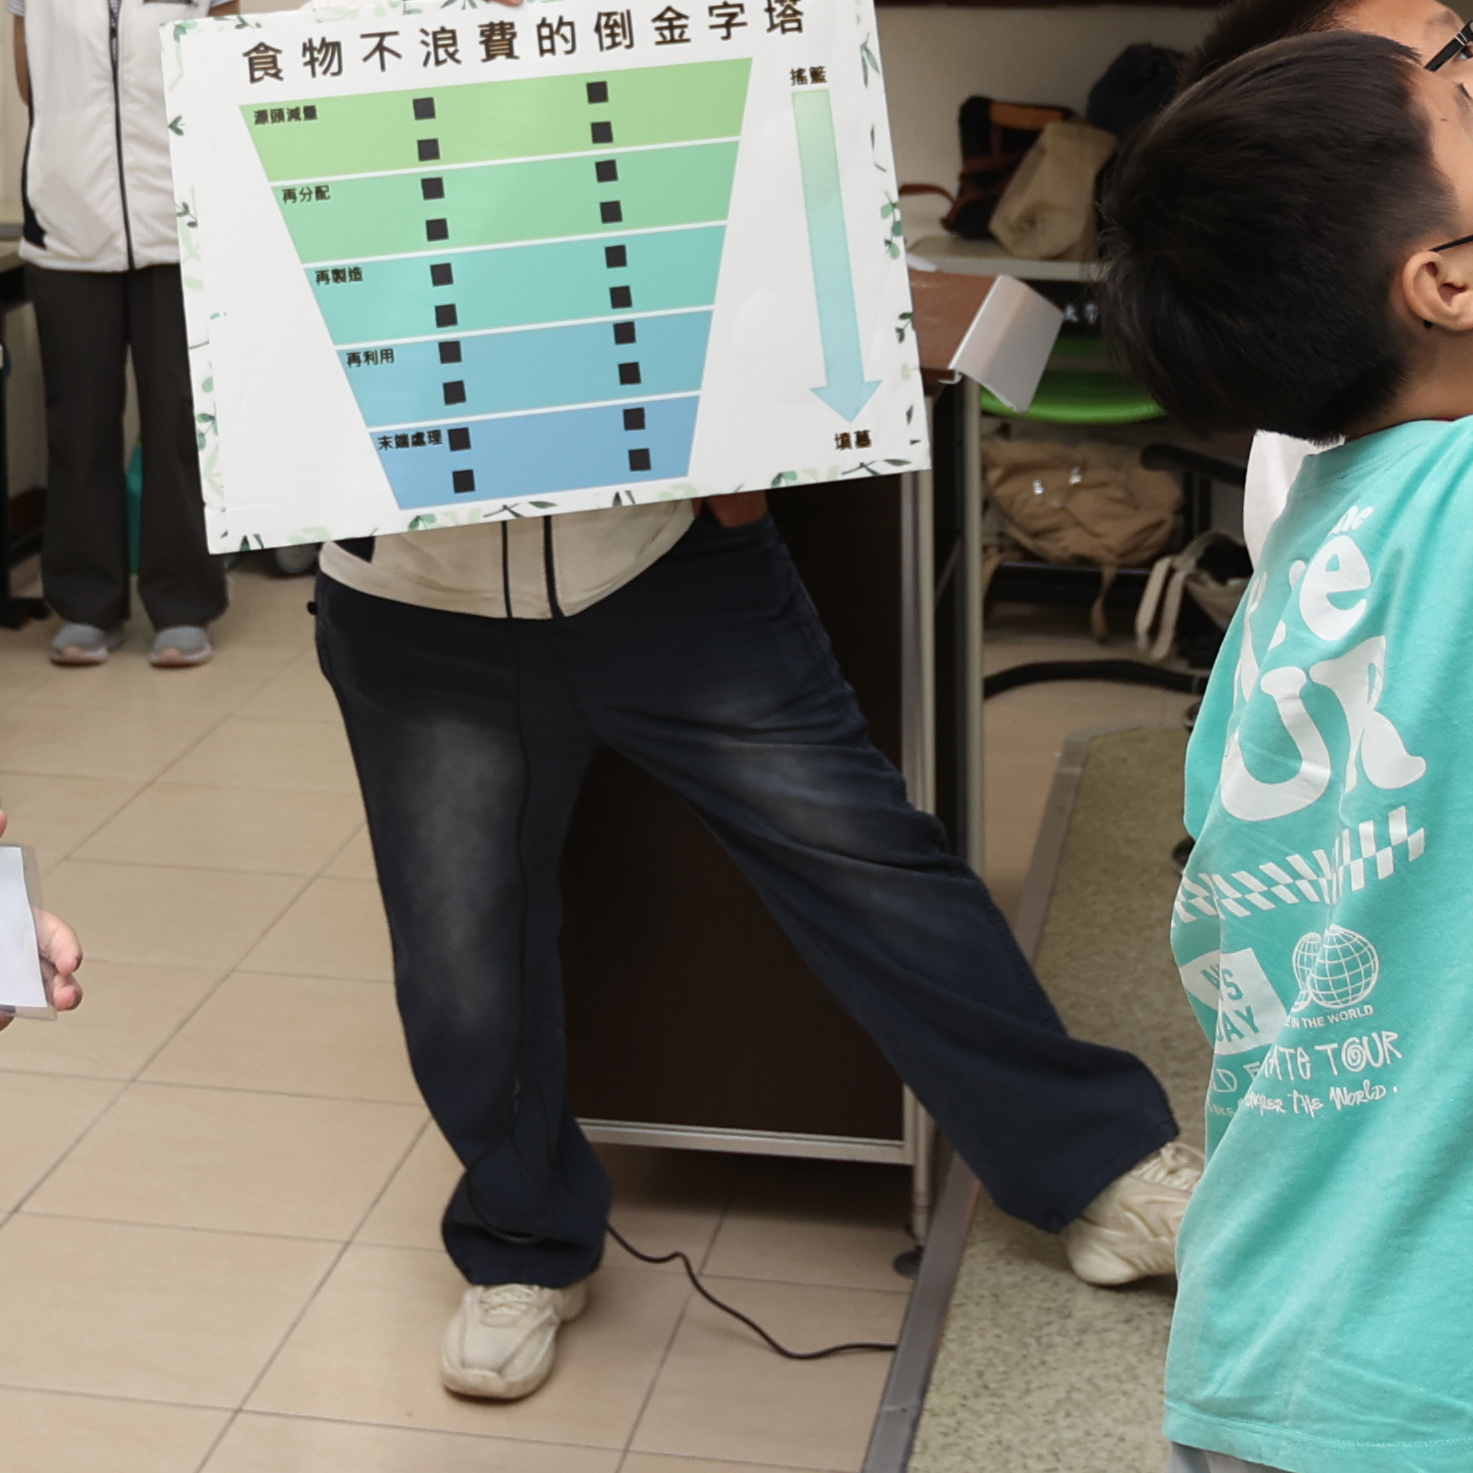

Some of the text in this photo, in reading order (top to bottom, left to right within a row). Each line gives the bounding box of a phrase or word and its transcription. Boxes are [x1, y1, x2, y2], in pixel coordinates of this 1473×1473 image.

[253, 105, 318, 126] 源頭減量
[282, 184, 331, 205] 再分配
[315, 266, 364, 286] 再製造
[346, 348, 395, 368] 再利用
[378, 429, 443, 451] 末端處理
[1327, 1004, 1374, 1025] WORLD
[1314, 1030, 1402, 1076] TOUR
